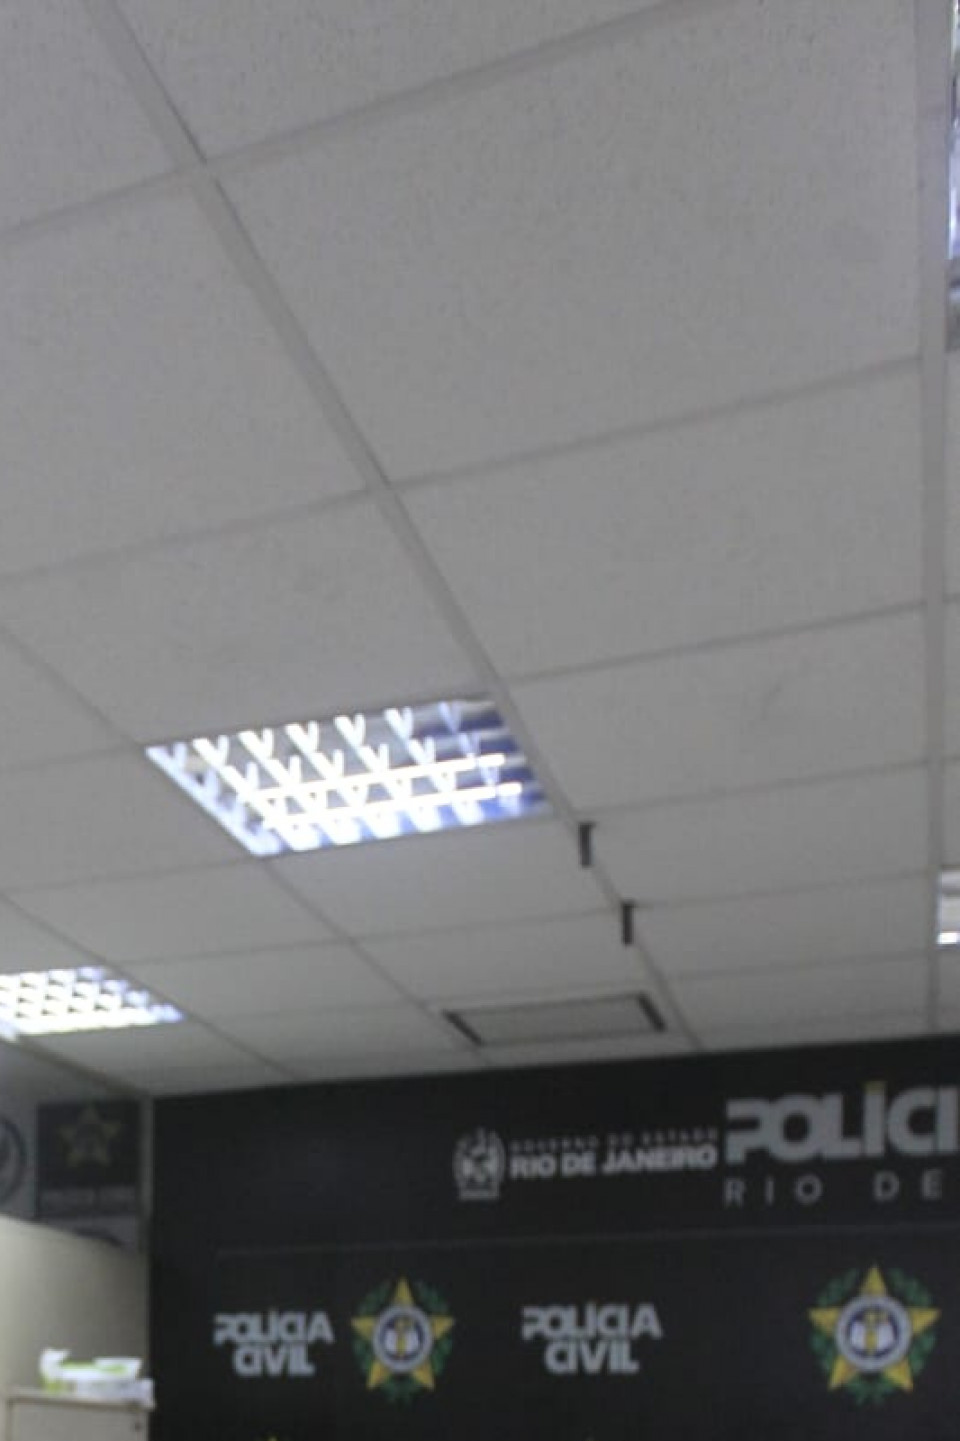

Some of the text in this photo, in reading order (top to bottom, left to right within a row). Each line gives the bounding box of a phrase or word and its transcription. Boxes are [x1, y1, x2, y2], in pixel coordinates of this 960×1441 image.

[509, 1143, 718, 1178] RIO DE JANEIRO
[724, 1168, 944, 1207] RIO DE
[233, 1344, 316, 1376] CIVIL
[544, 1340, 640, 1374] CIVIL
